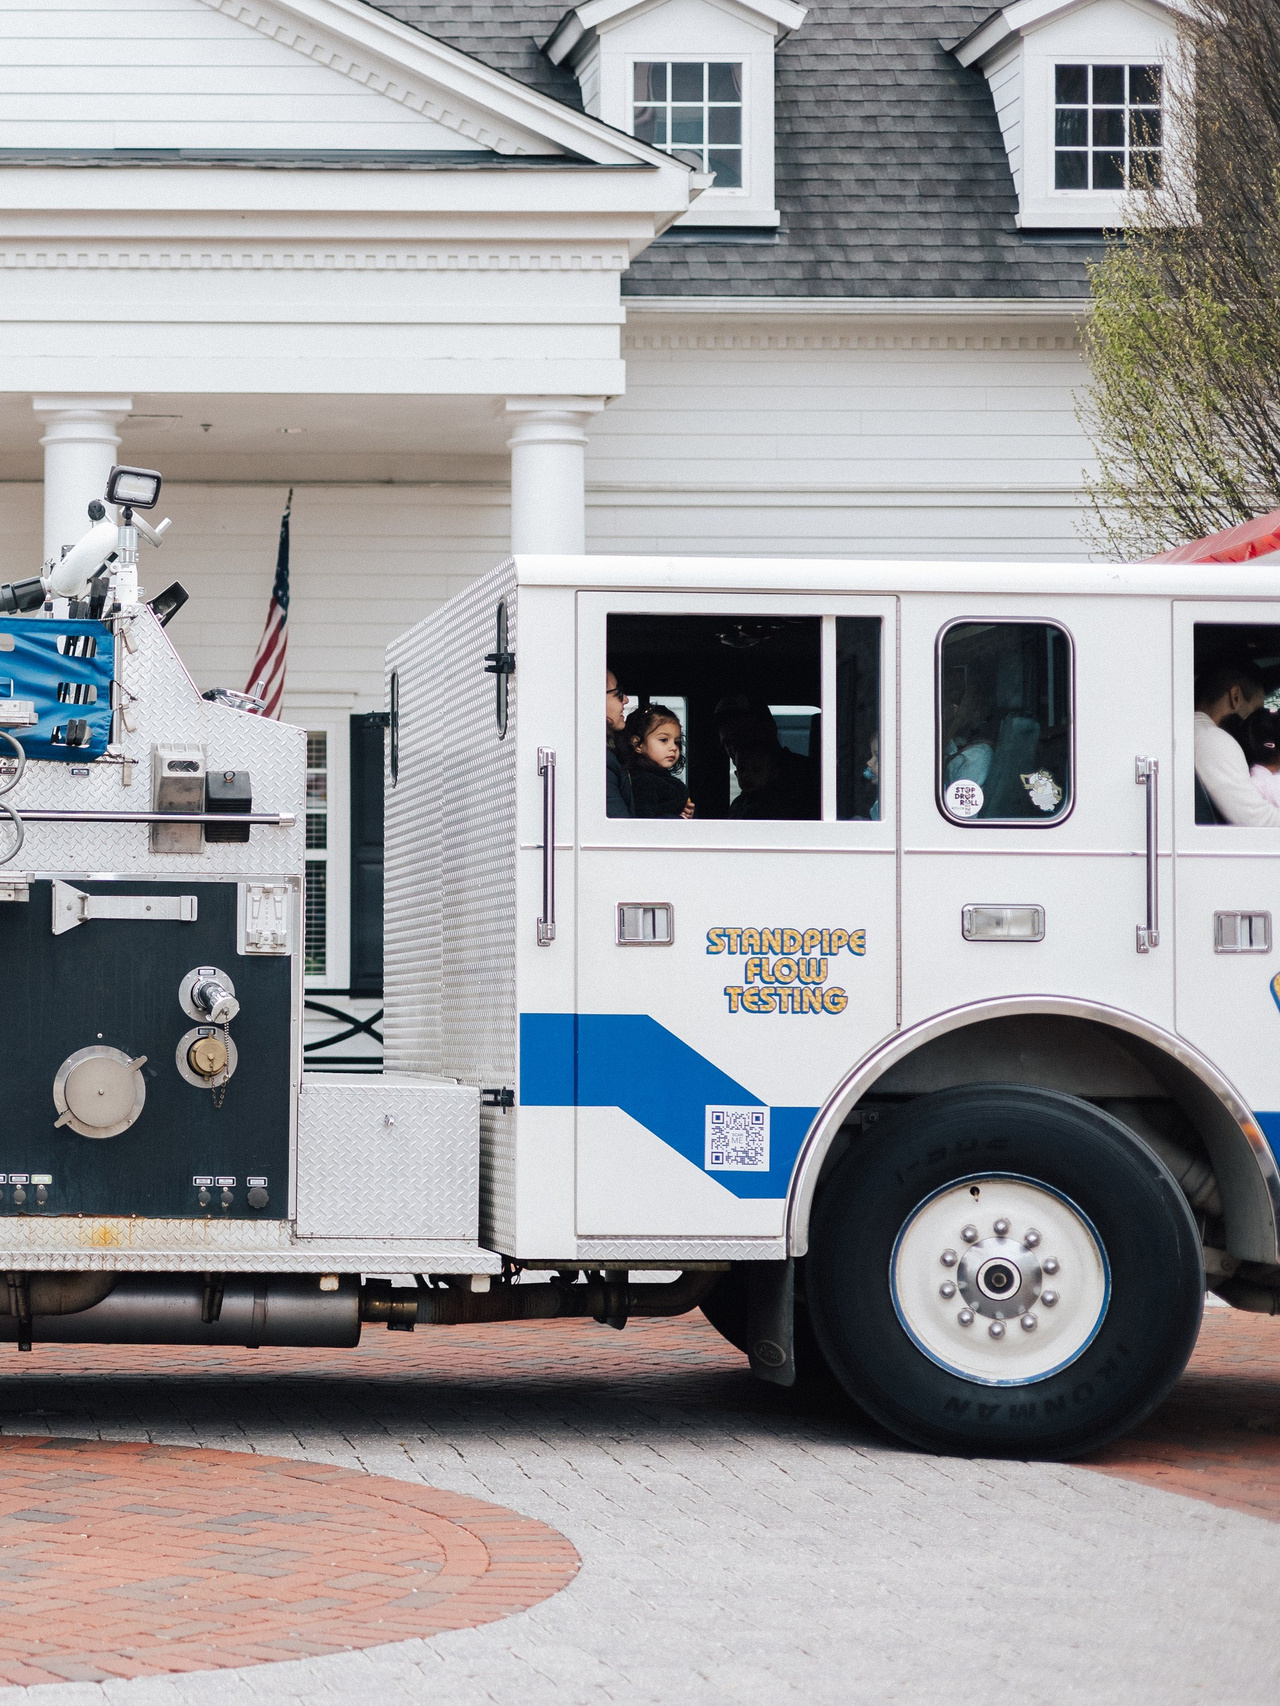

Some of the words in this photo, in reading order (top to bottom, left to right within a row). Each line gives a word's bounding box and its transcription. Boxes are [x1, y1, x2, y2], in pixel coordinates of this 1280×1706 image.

[706, 927, 867, 956] STANDPIPE
[745, 957, 829, 985] FLOW
[724, 985, 849, 1015] TESTING
